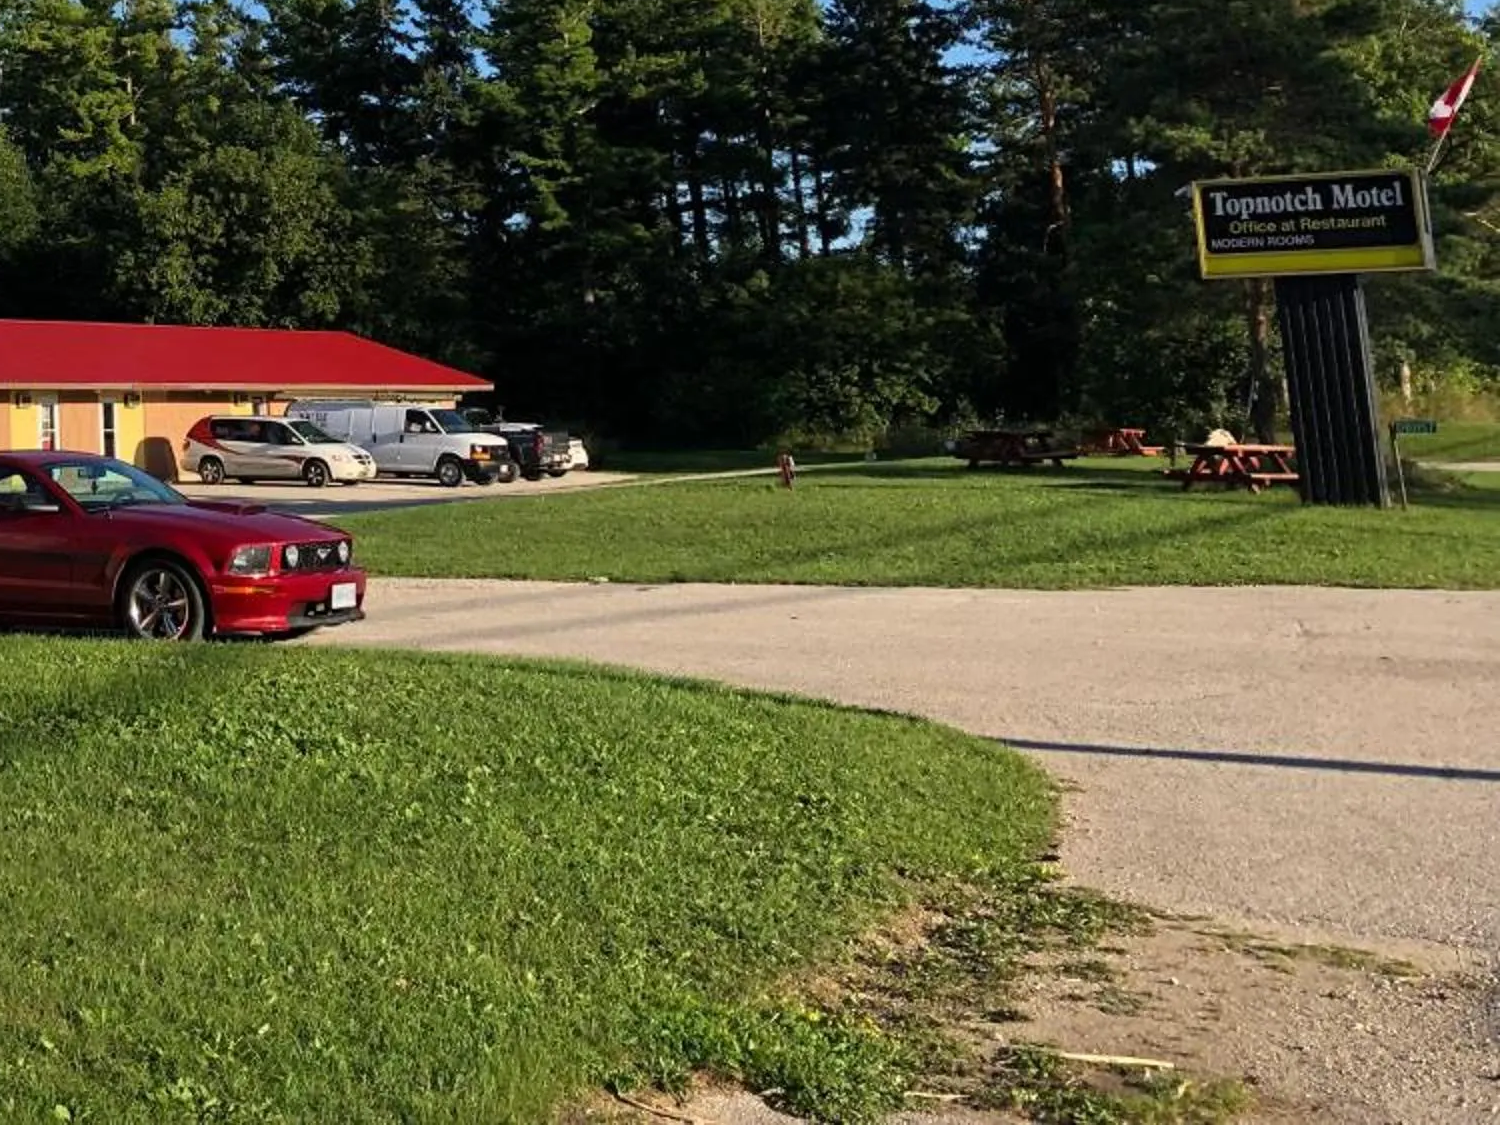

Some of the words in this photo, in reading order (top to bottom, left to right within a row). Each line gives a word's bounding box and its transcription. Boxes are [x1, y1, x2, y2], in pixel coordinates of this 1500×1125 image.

[1209, 185, 1324, 220] Topnotch
[1331, 180, 1404, 209] Motel
[1229, 220, 1277, 234] Office
[1281, 218, 1296, 232] at
[1300, 215, 1386, 230] Restaurant
[1211, 236, 1265, 250] MODERN
[1267, 234, 1315, 246] ROOMS
